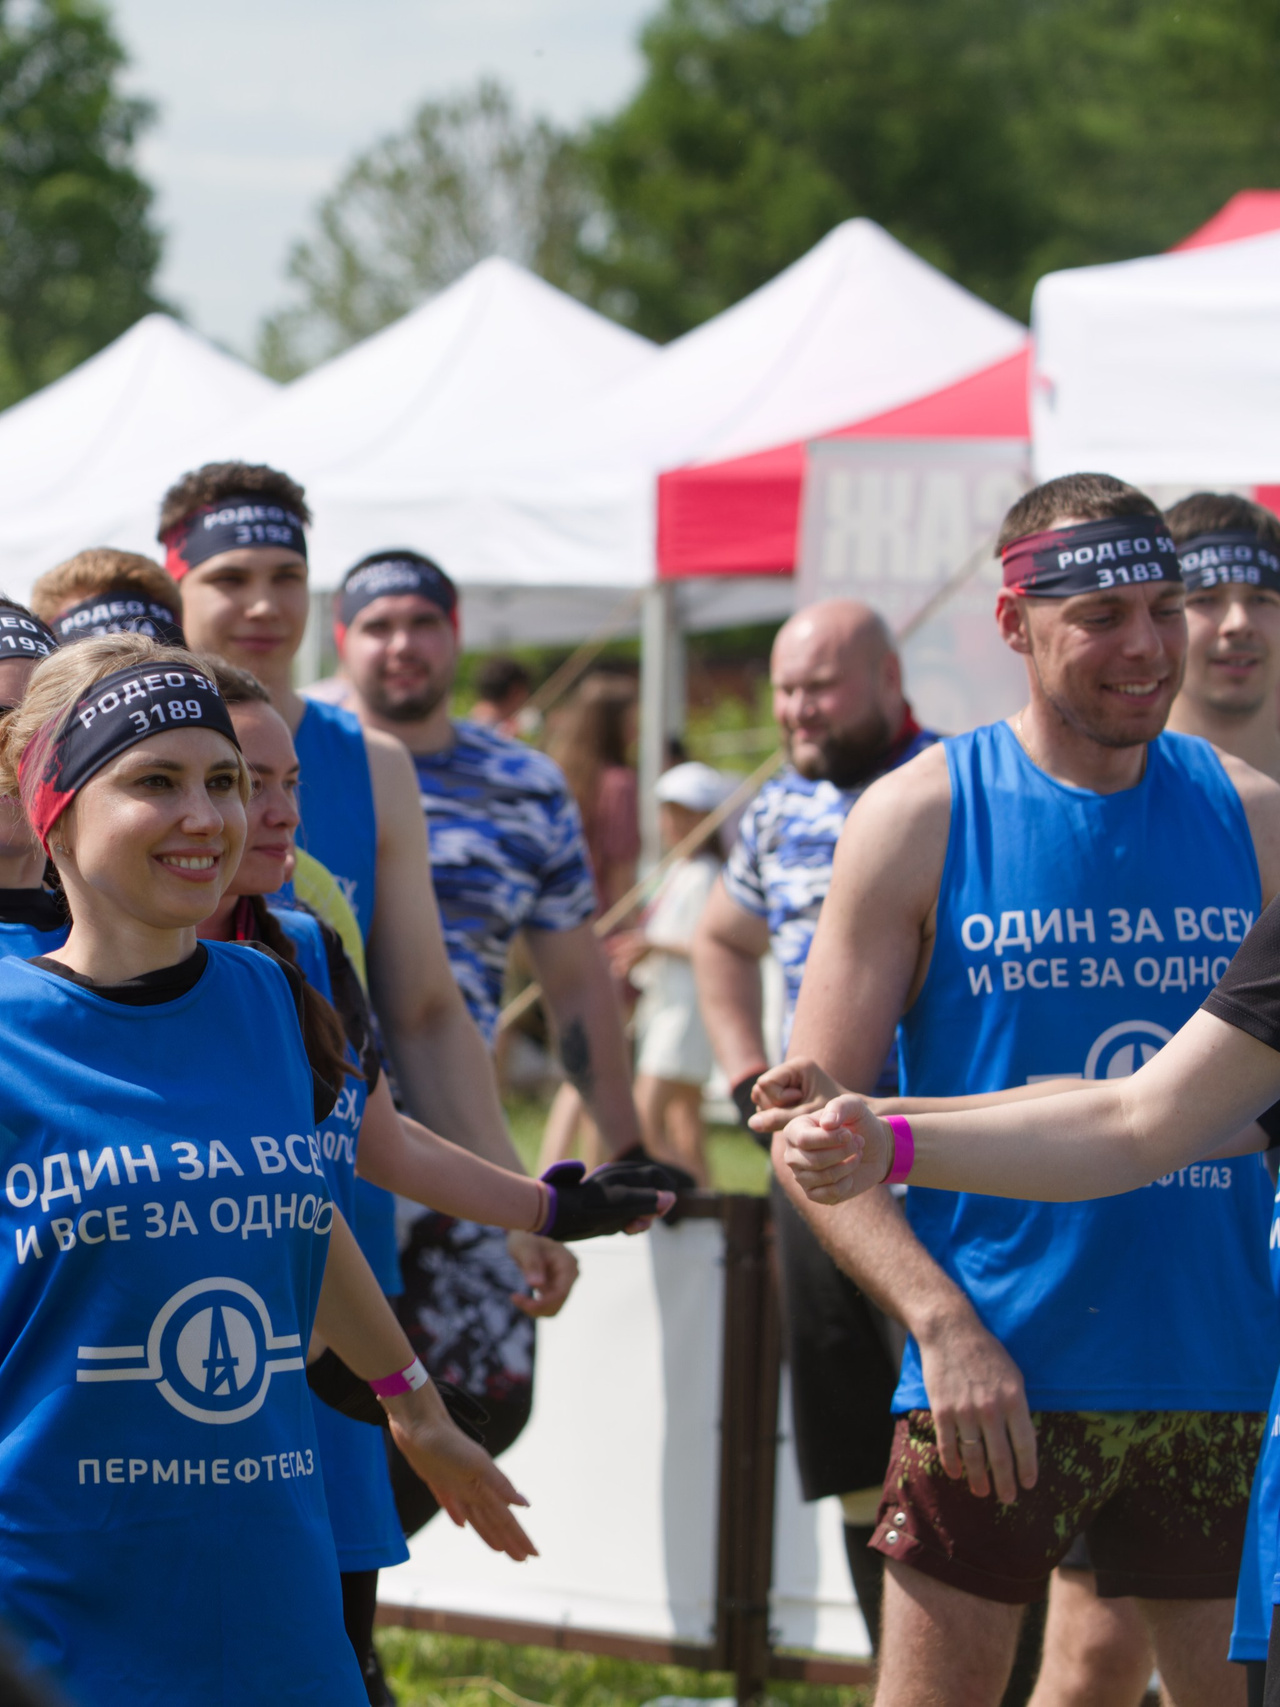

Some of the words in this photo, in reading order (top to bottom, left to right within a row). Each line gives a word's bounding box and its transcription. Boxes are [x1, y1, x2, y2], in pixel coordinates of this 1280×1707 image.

[203, 505, 284, 531] РОДЕО
[1058, 537, 1151, 570] РОДЕО
[1178, 545, 1253, 572] ОДЕО
[1097, 562, 1164, 589] 3183
[60, 600, 145, 636] РОДЕО
[79, 672, 186, 729] РОДЕО
[192, 674, 220, 697] 59
[128, 699, 202, 734] 3189
[961, 908, 1096, 956] ОДИН
[1108, 907, 1165, 943] ЗА
[968, 964, 993, 996] И
[1002, 958, 1069, 991] ВСЕ
[1079, 957, 1125, 988] ЗА
[1133, 957, 1231, 994] ОДНО
[5, 1144, 161, 1213] ОДИН
[171, 1140, 245, 1181] ЗА
[250, 1134, 325, 1178] ВСЕ
[15, 1224, 44, 1264] И
[51, 1205, 131, 1252] ВСЕ
[143, 1200, 199, 1239] ЗА
[78, 1448, 314, 1485] ПЕРМНЕФТЕГАЗ
